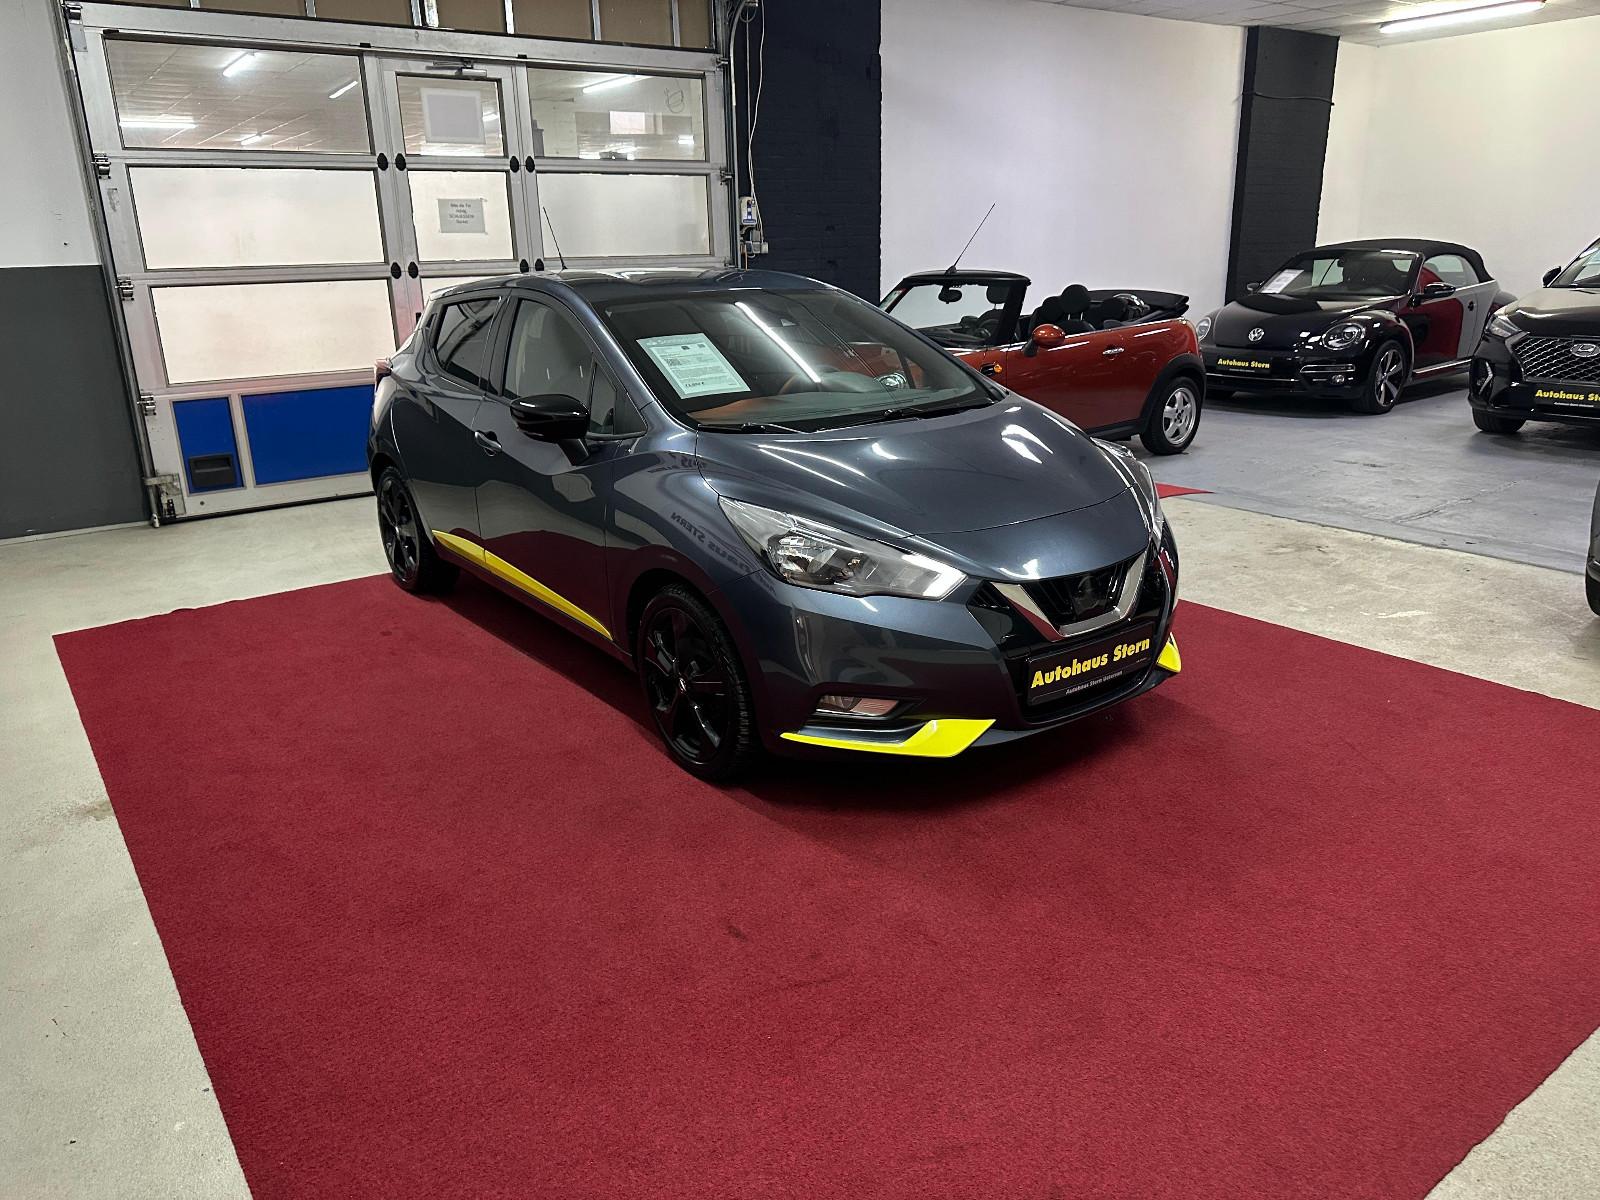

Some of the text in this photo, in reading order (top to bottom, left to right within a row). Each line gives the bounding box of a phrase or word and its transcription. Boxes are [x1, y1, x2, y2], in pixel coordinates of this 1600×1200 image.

[1217, 358, 1270, 369] Autohaus Stern
[1535, 389, 1600, 401] Autohaus St
[1031, 638, 1150, 688] Autohaus Stern
